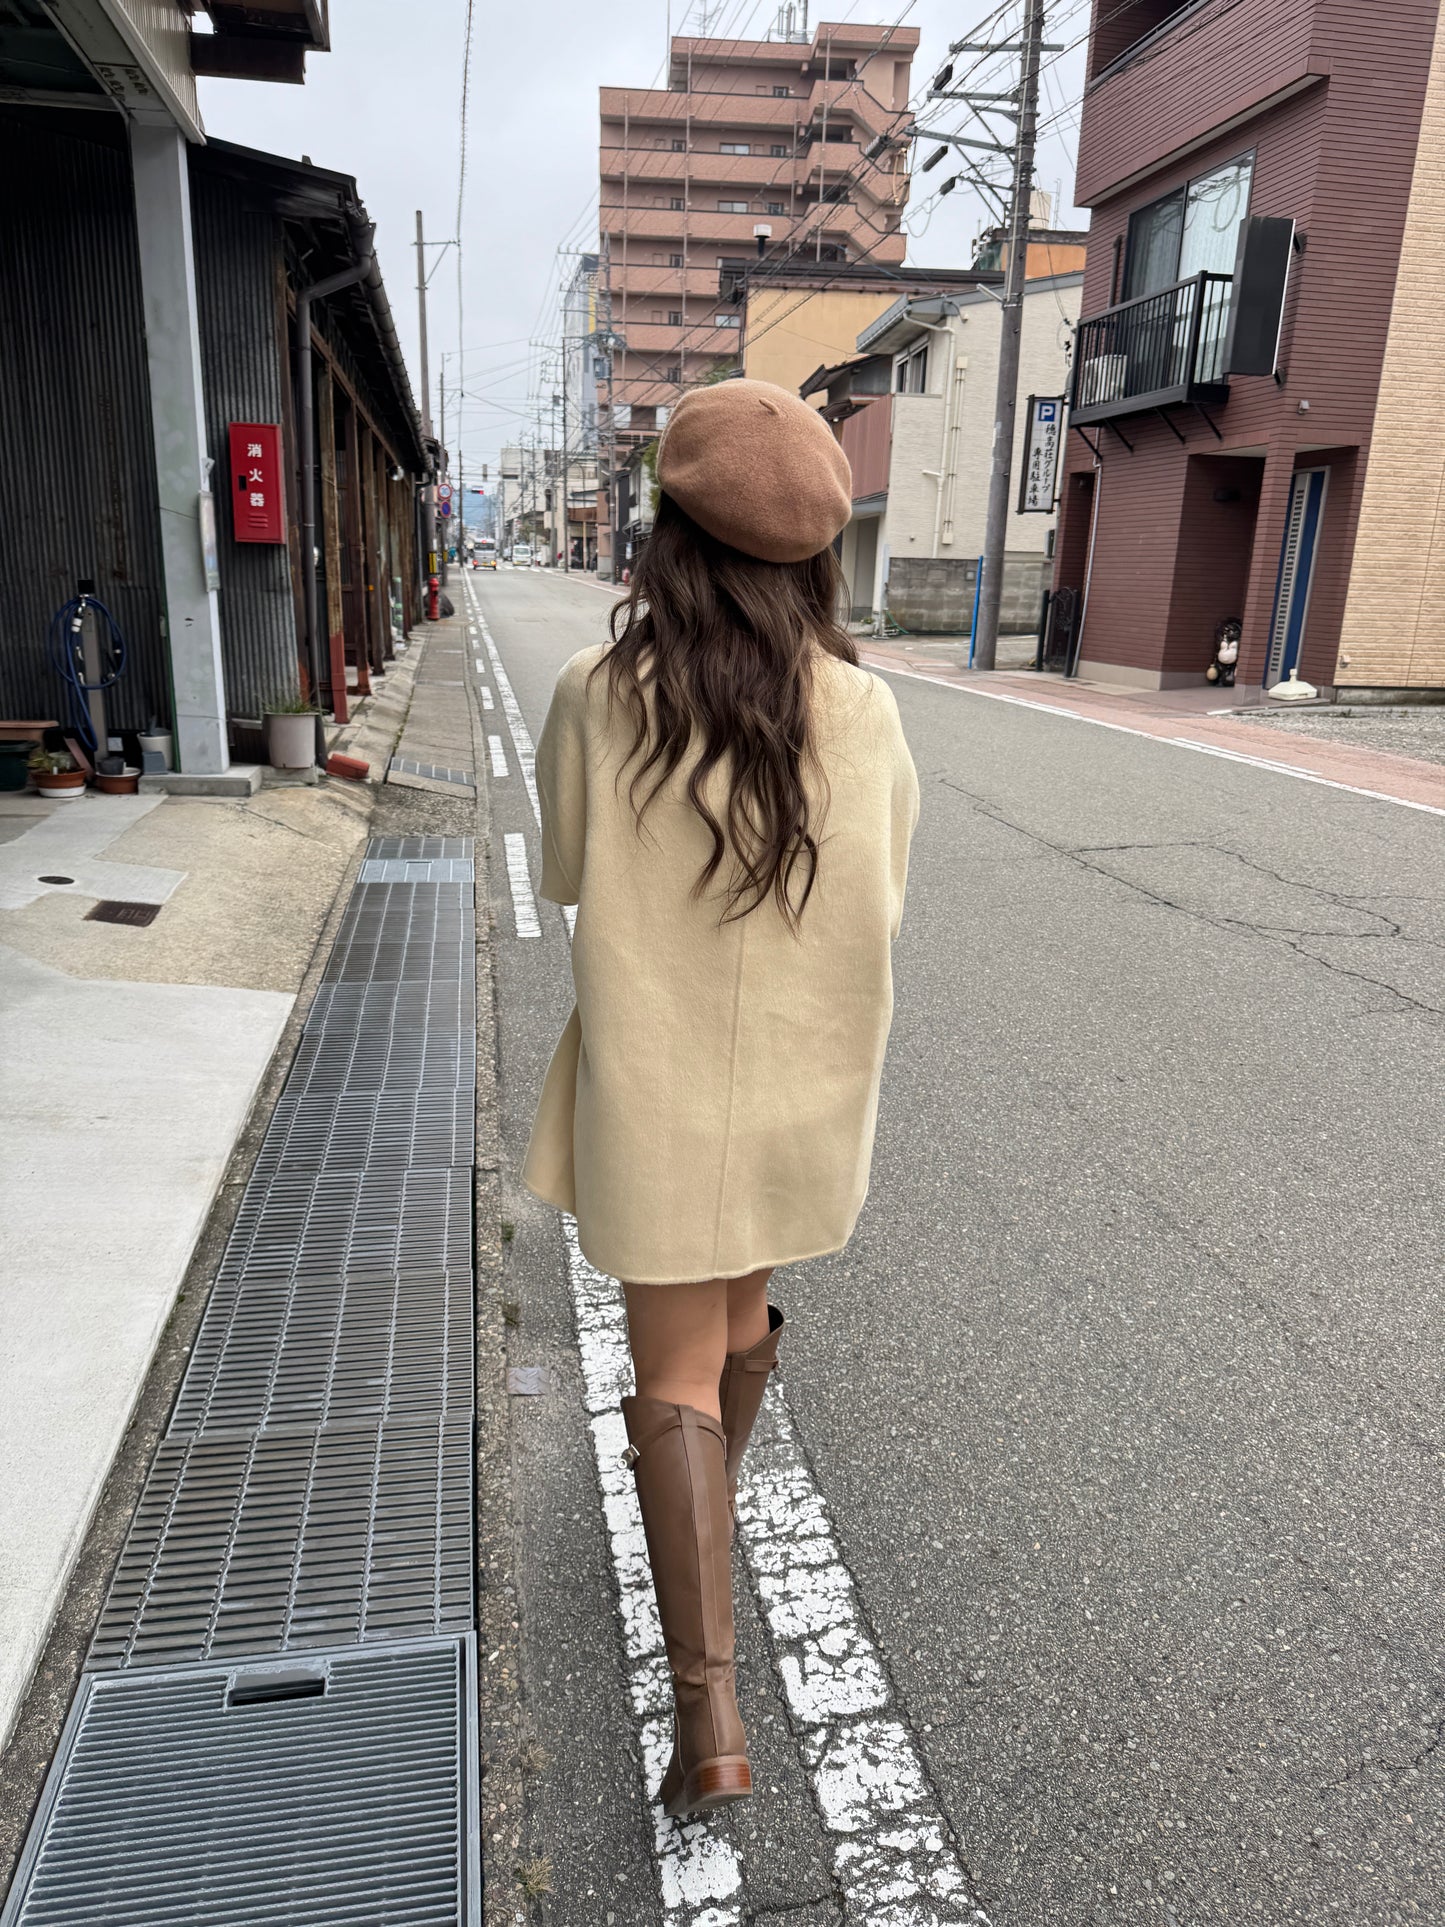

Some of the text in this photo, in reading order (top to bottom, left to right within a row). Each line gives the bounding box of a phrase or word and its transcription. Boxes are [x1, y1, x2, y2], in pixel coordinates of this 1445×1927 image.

[1041, 405, 1054, 420] P
[247, 443, 264, 507] 消火器
[1028, 447, 1043, 507] 専用駐車場
